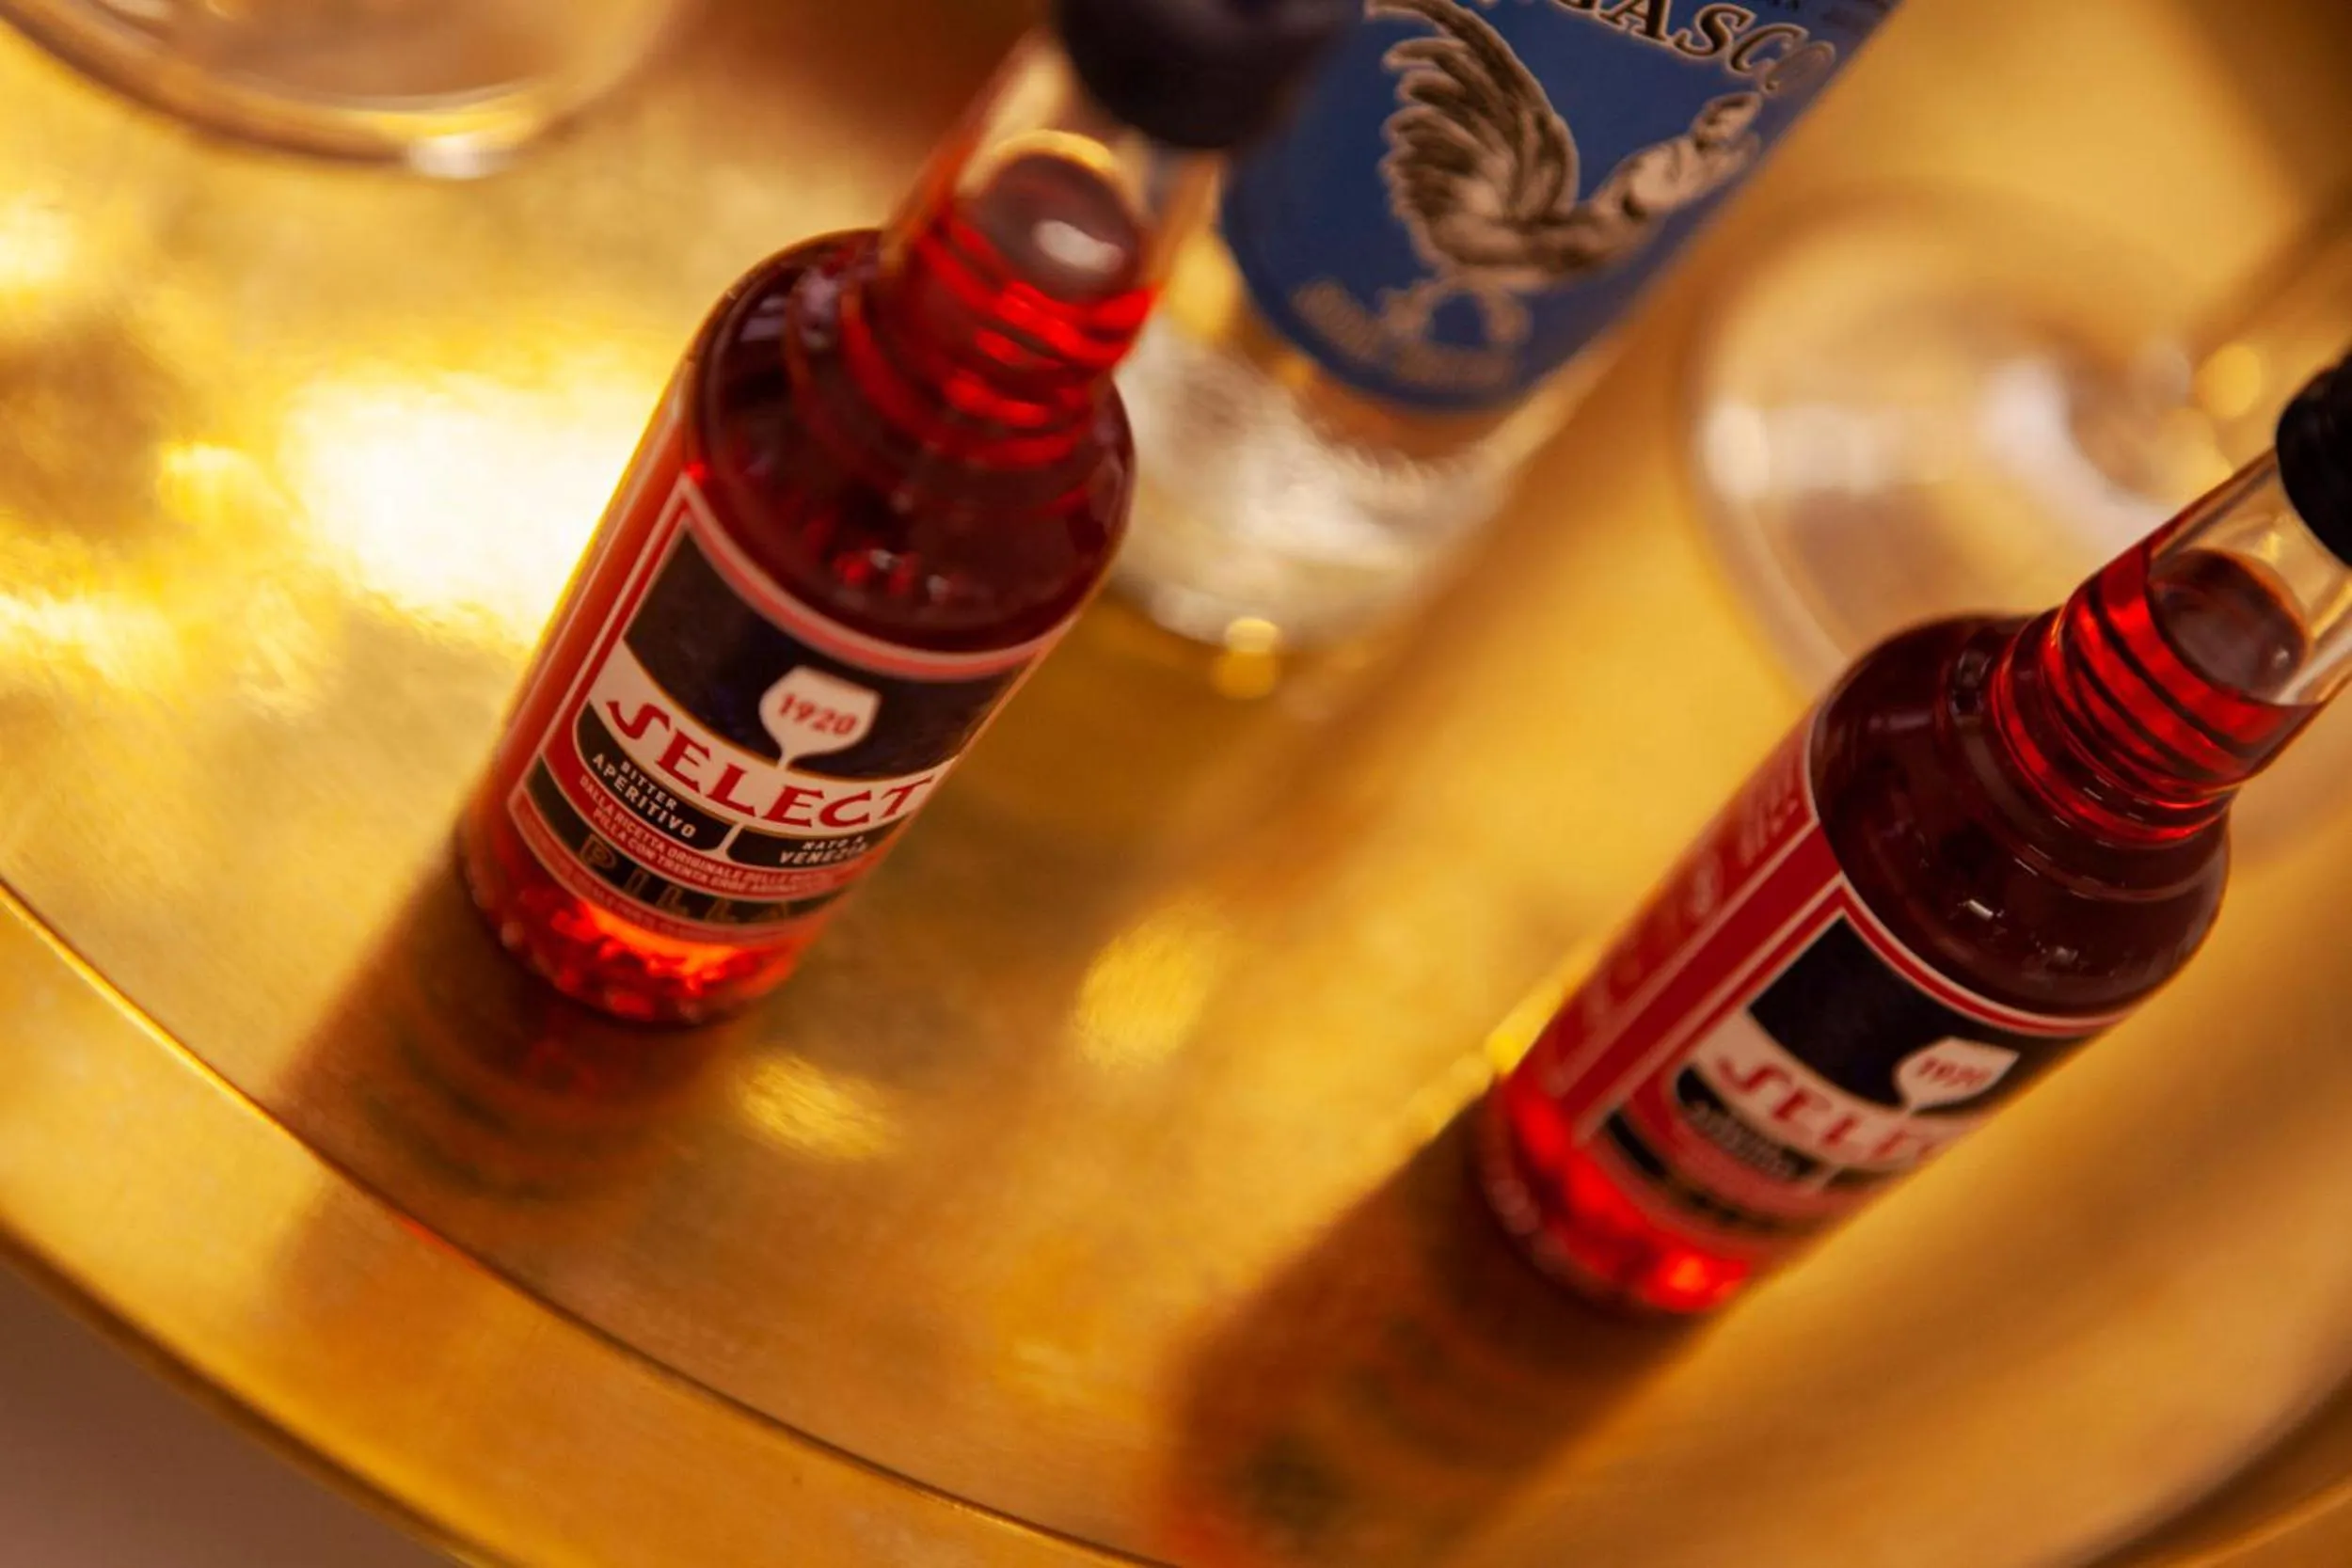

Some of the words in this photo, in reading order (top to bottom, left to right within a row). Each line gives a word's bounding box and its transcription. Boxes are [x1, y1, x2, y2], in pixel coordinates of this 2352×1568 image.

[776, 689, 858, 737] 1920
[592, 752, 696, 838] APERITIVO
[605, 698, 934, 828] SELECT
[620, 760, 677, 811] BITTER
[580, 774, 614, 814] DALLA
[614, 811, 665, 853] RICETTA
